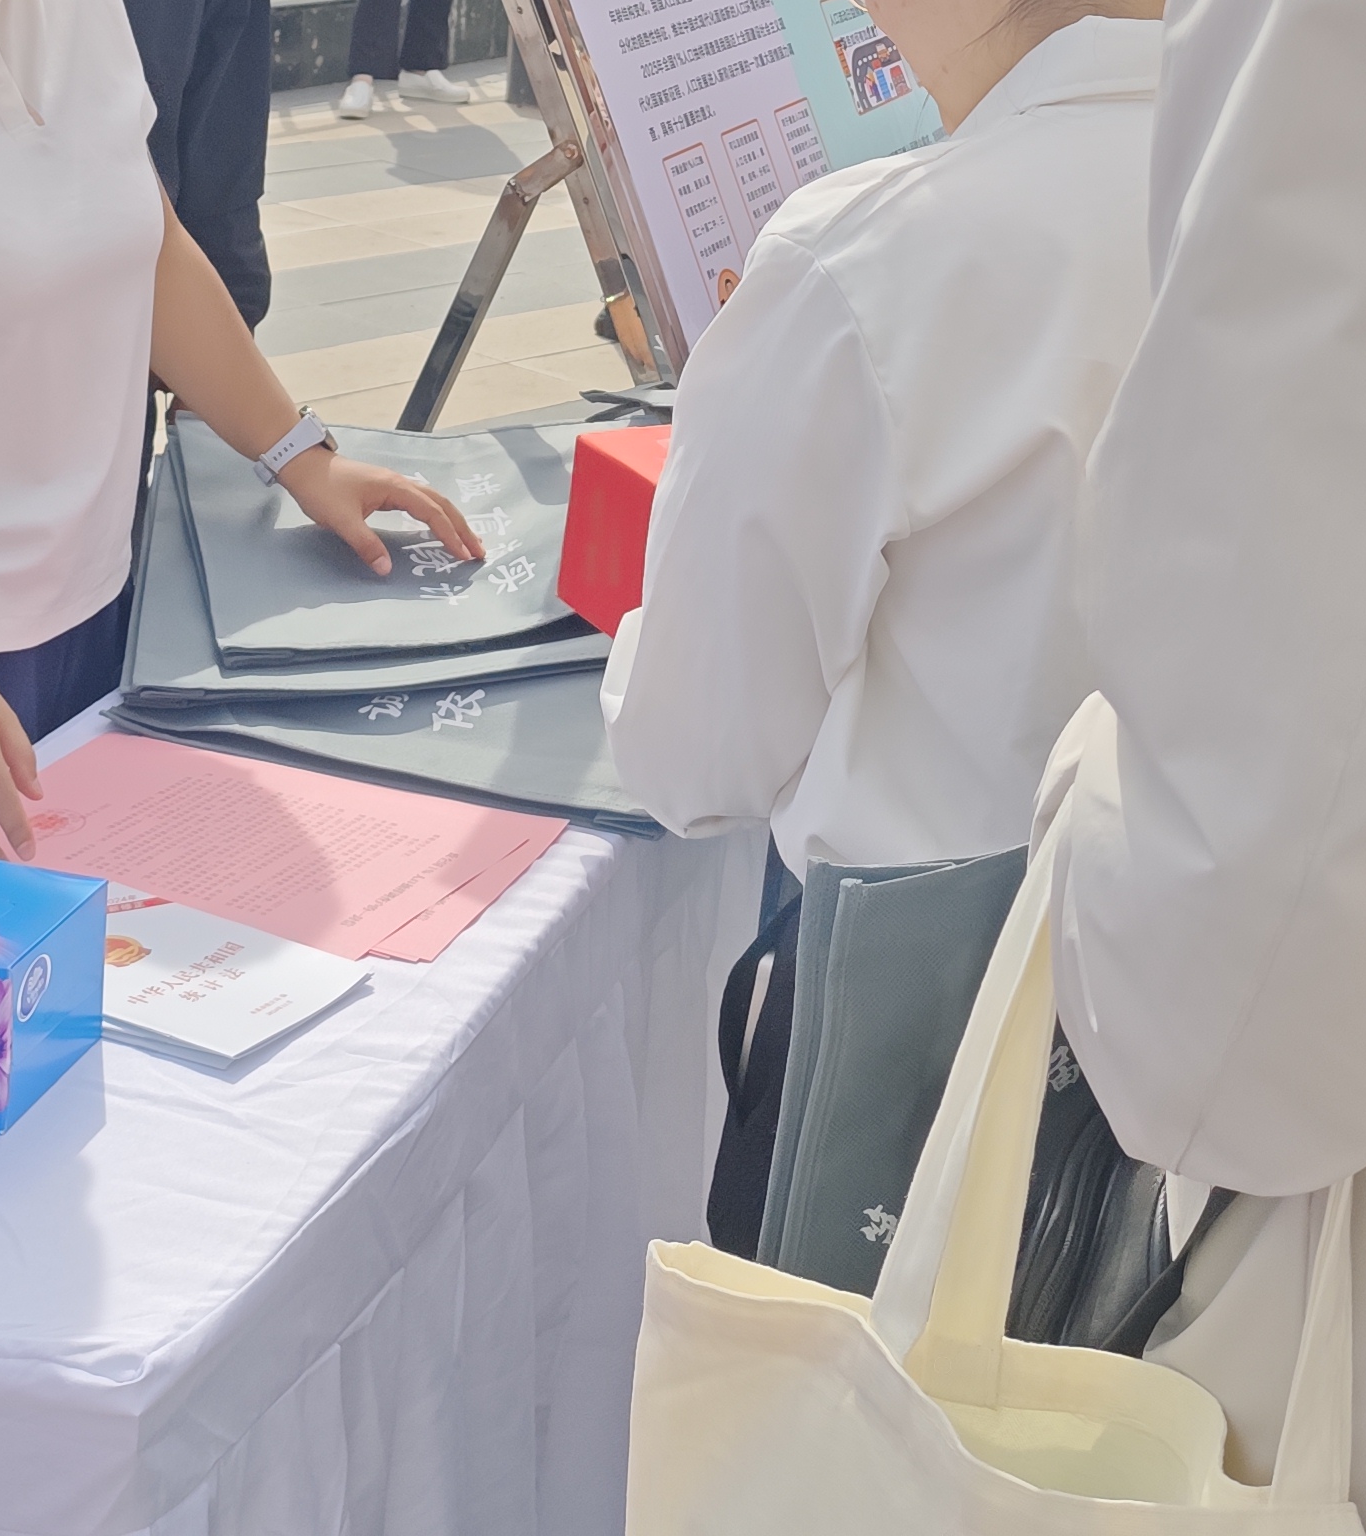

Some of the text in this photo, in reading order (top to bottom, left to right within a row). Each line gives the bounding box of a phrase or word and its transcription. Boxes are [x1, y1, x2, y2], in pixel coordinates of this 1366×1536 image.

[126, 940, 246, 1005] 中华人民共和国
[178, 966, 246, 1004] 统计法
